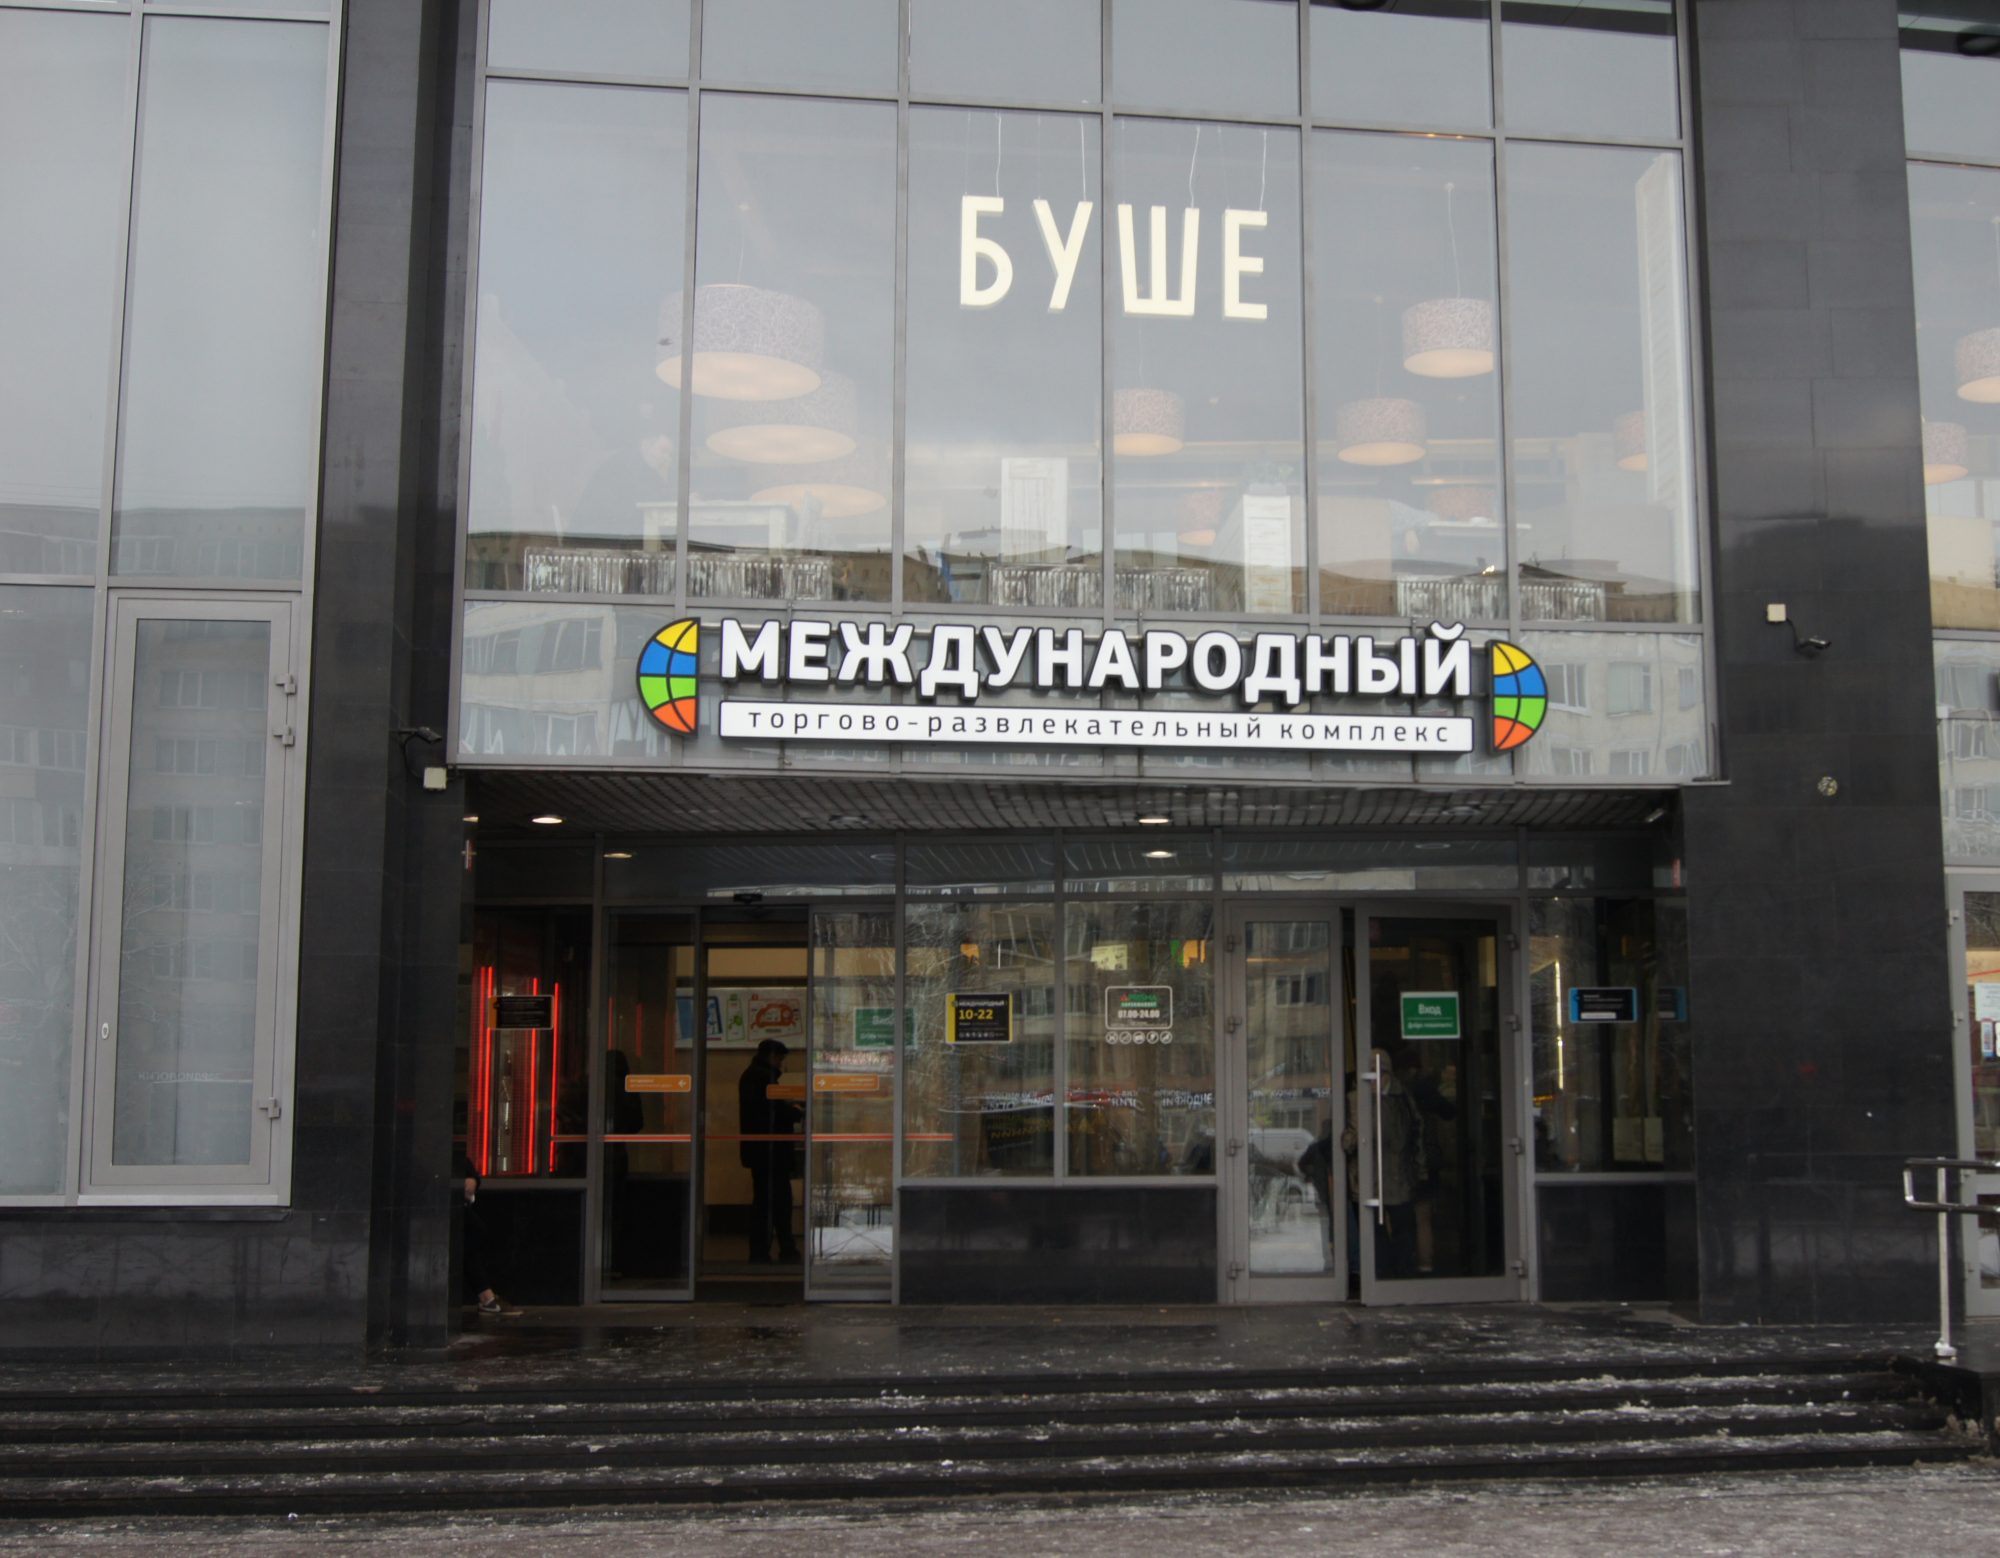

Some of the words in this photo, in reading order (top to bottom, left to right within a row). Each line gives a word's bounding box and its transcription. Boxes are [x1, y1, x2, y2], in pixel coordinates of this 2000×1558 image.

[960, 195, 1268, 321] БУШЕ
[719, 617, 1472, 706] МЕЖДУНАРОДНЫЙ
[748, 710, 1261, 738] торгово-развлекательный
[1280, 722, 1448, 743] комплекс
[958, 1009, 994, 1020] 10-22
